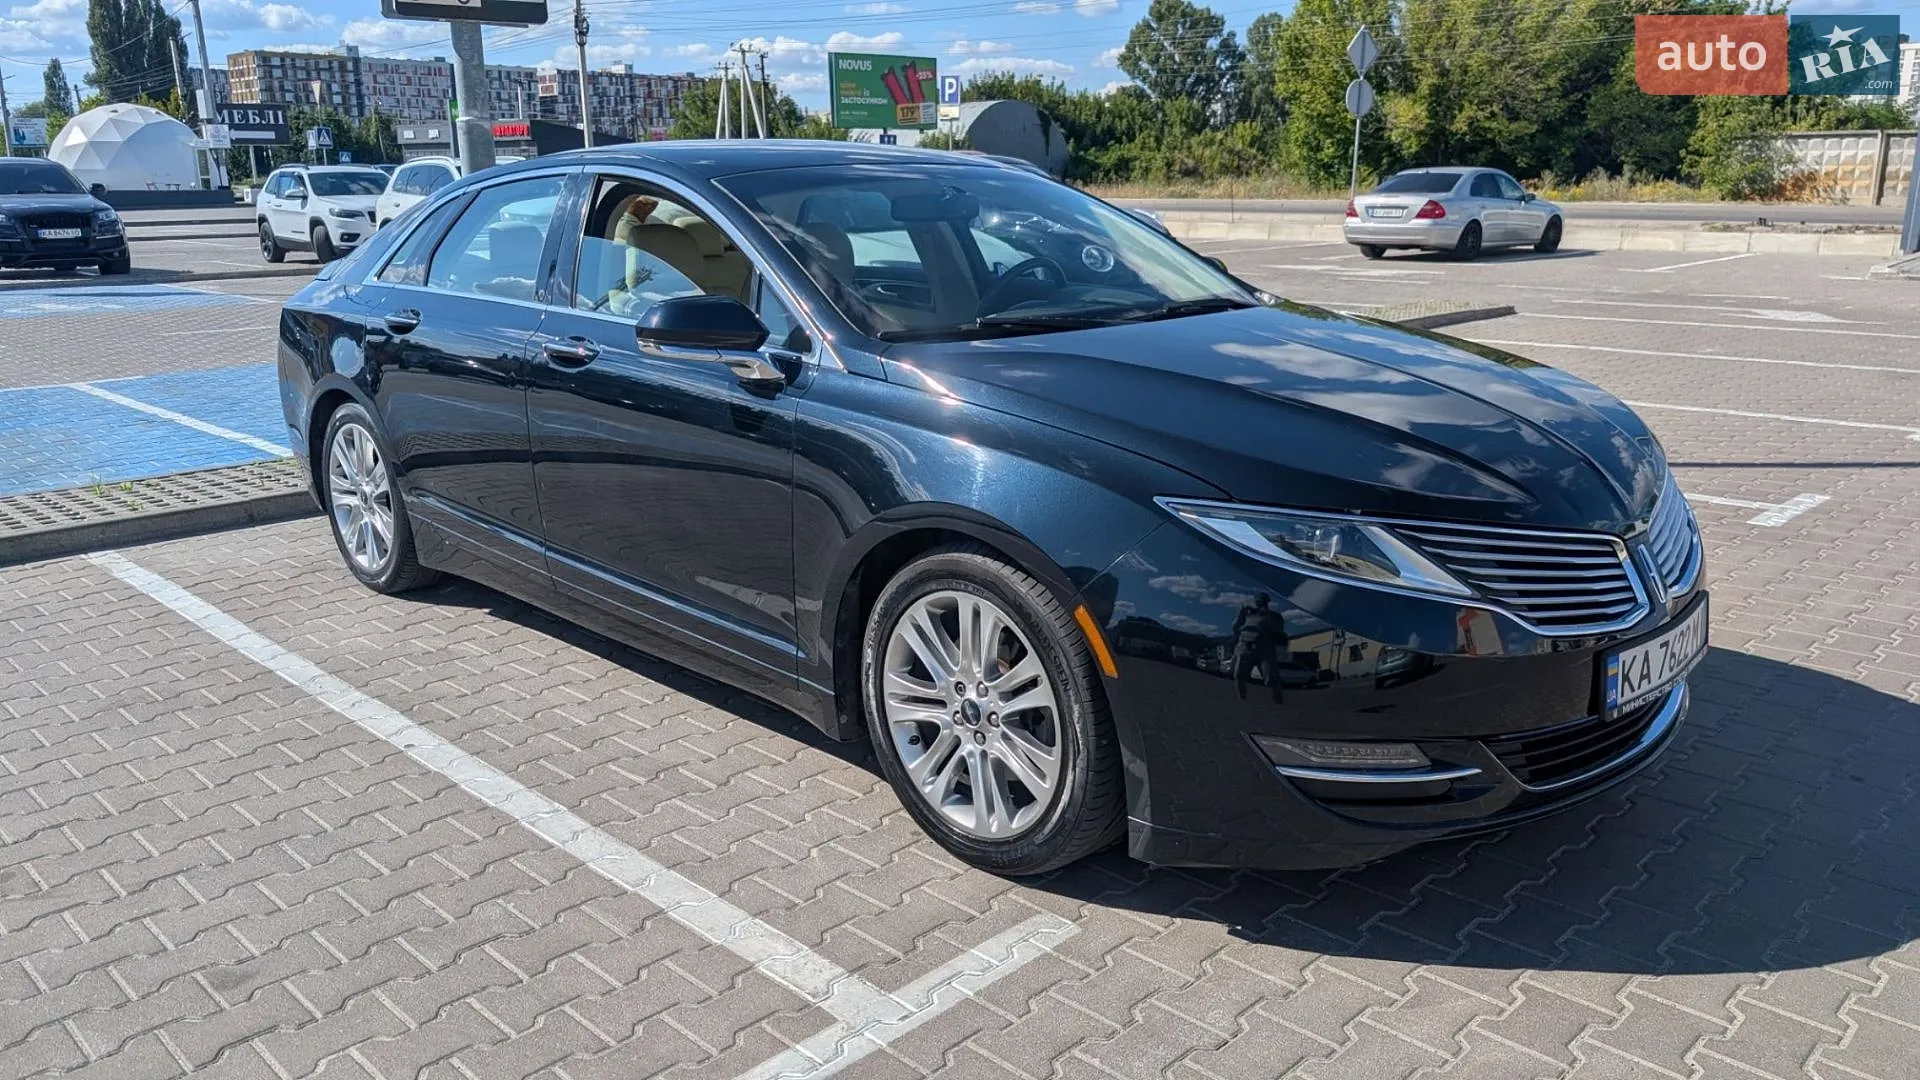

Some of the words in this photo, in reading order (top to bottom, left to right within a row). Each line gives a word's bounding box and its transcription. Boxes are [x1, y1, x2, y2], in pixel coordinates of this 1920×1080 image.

[839, 59, 873, 71] NOVUS
[945, 78, 957, 102] P
[216, 109, 285, 125] МЕБЛІ
[1621, 650, 1652, 698] KA
[1659, 624, 1691, 680] 7622
